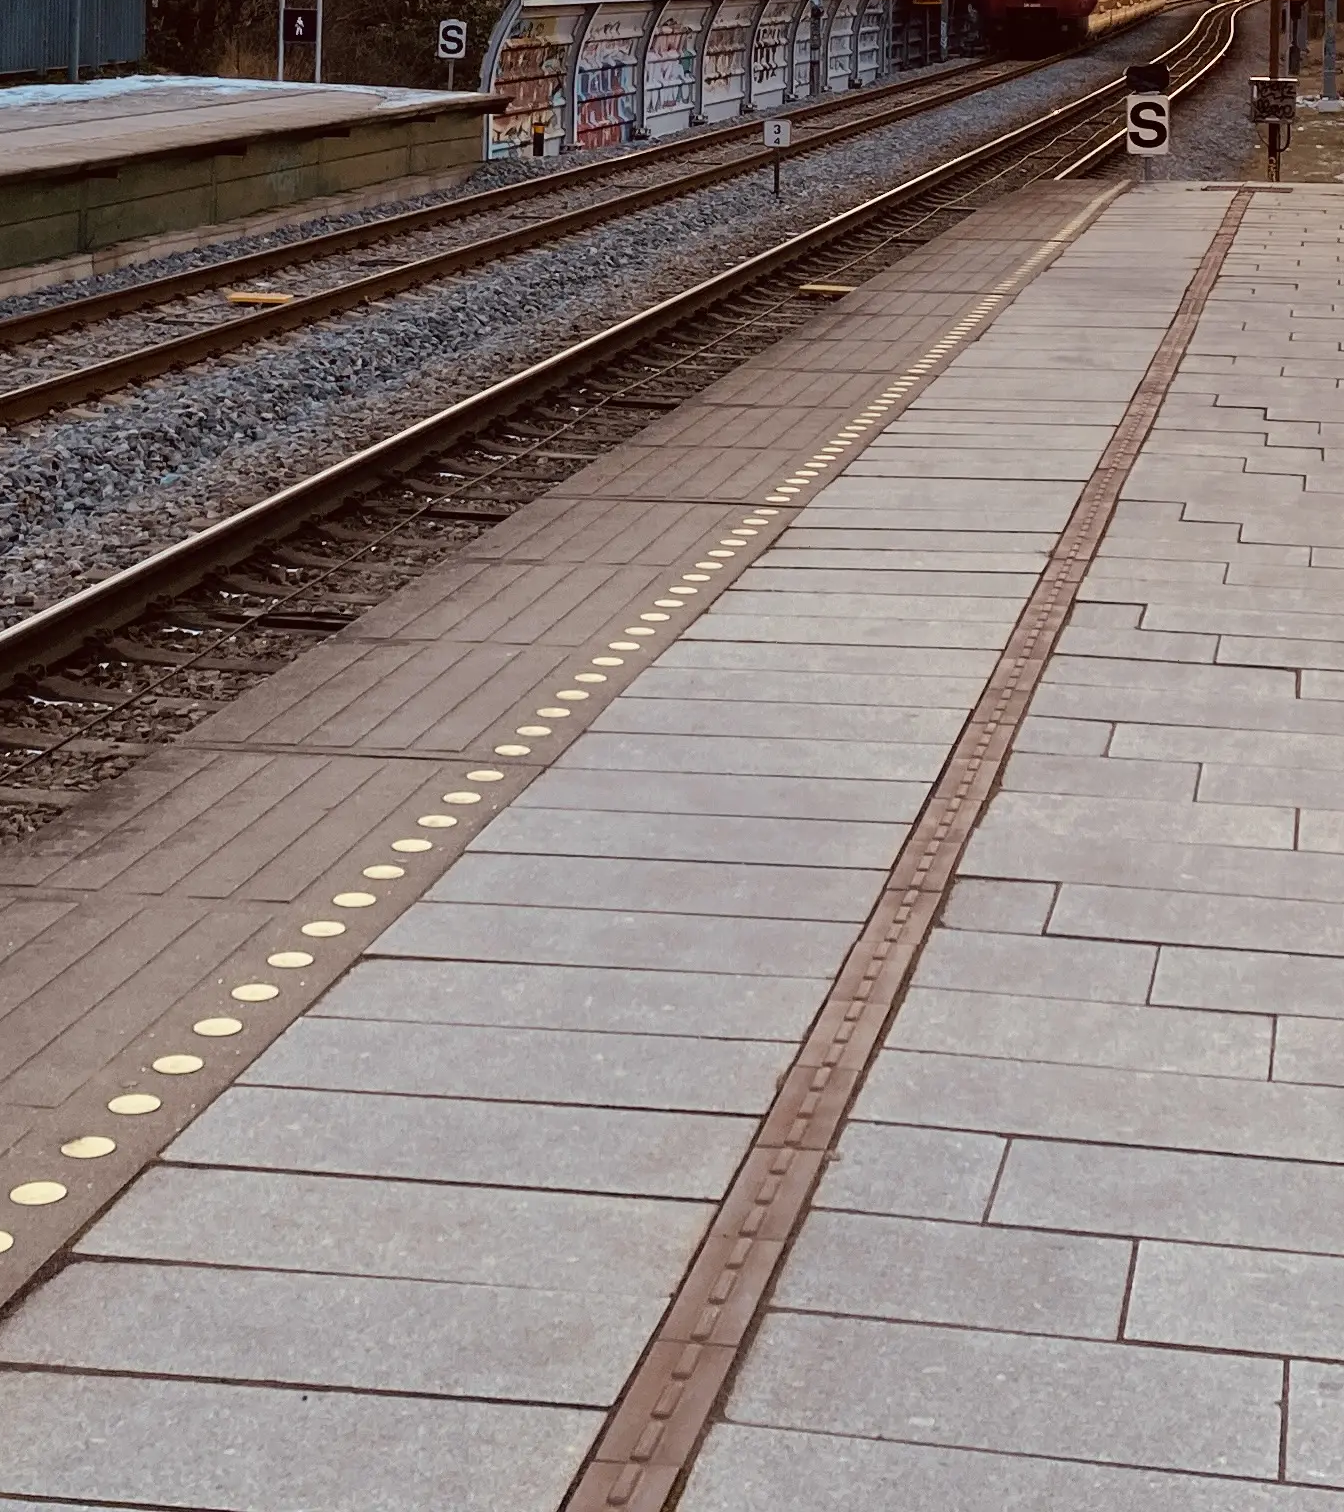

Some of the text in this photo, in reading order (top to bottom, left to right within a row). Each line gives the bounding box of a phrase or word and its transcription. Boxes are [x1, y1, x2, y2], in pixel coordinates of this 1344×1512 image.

[440, 24, 464, 55] S
[773, 124, 781, 135] 3
[1129, 101, 1167, 148] S
[773, 137, 781, 146] 4
